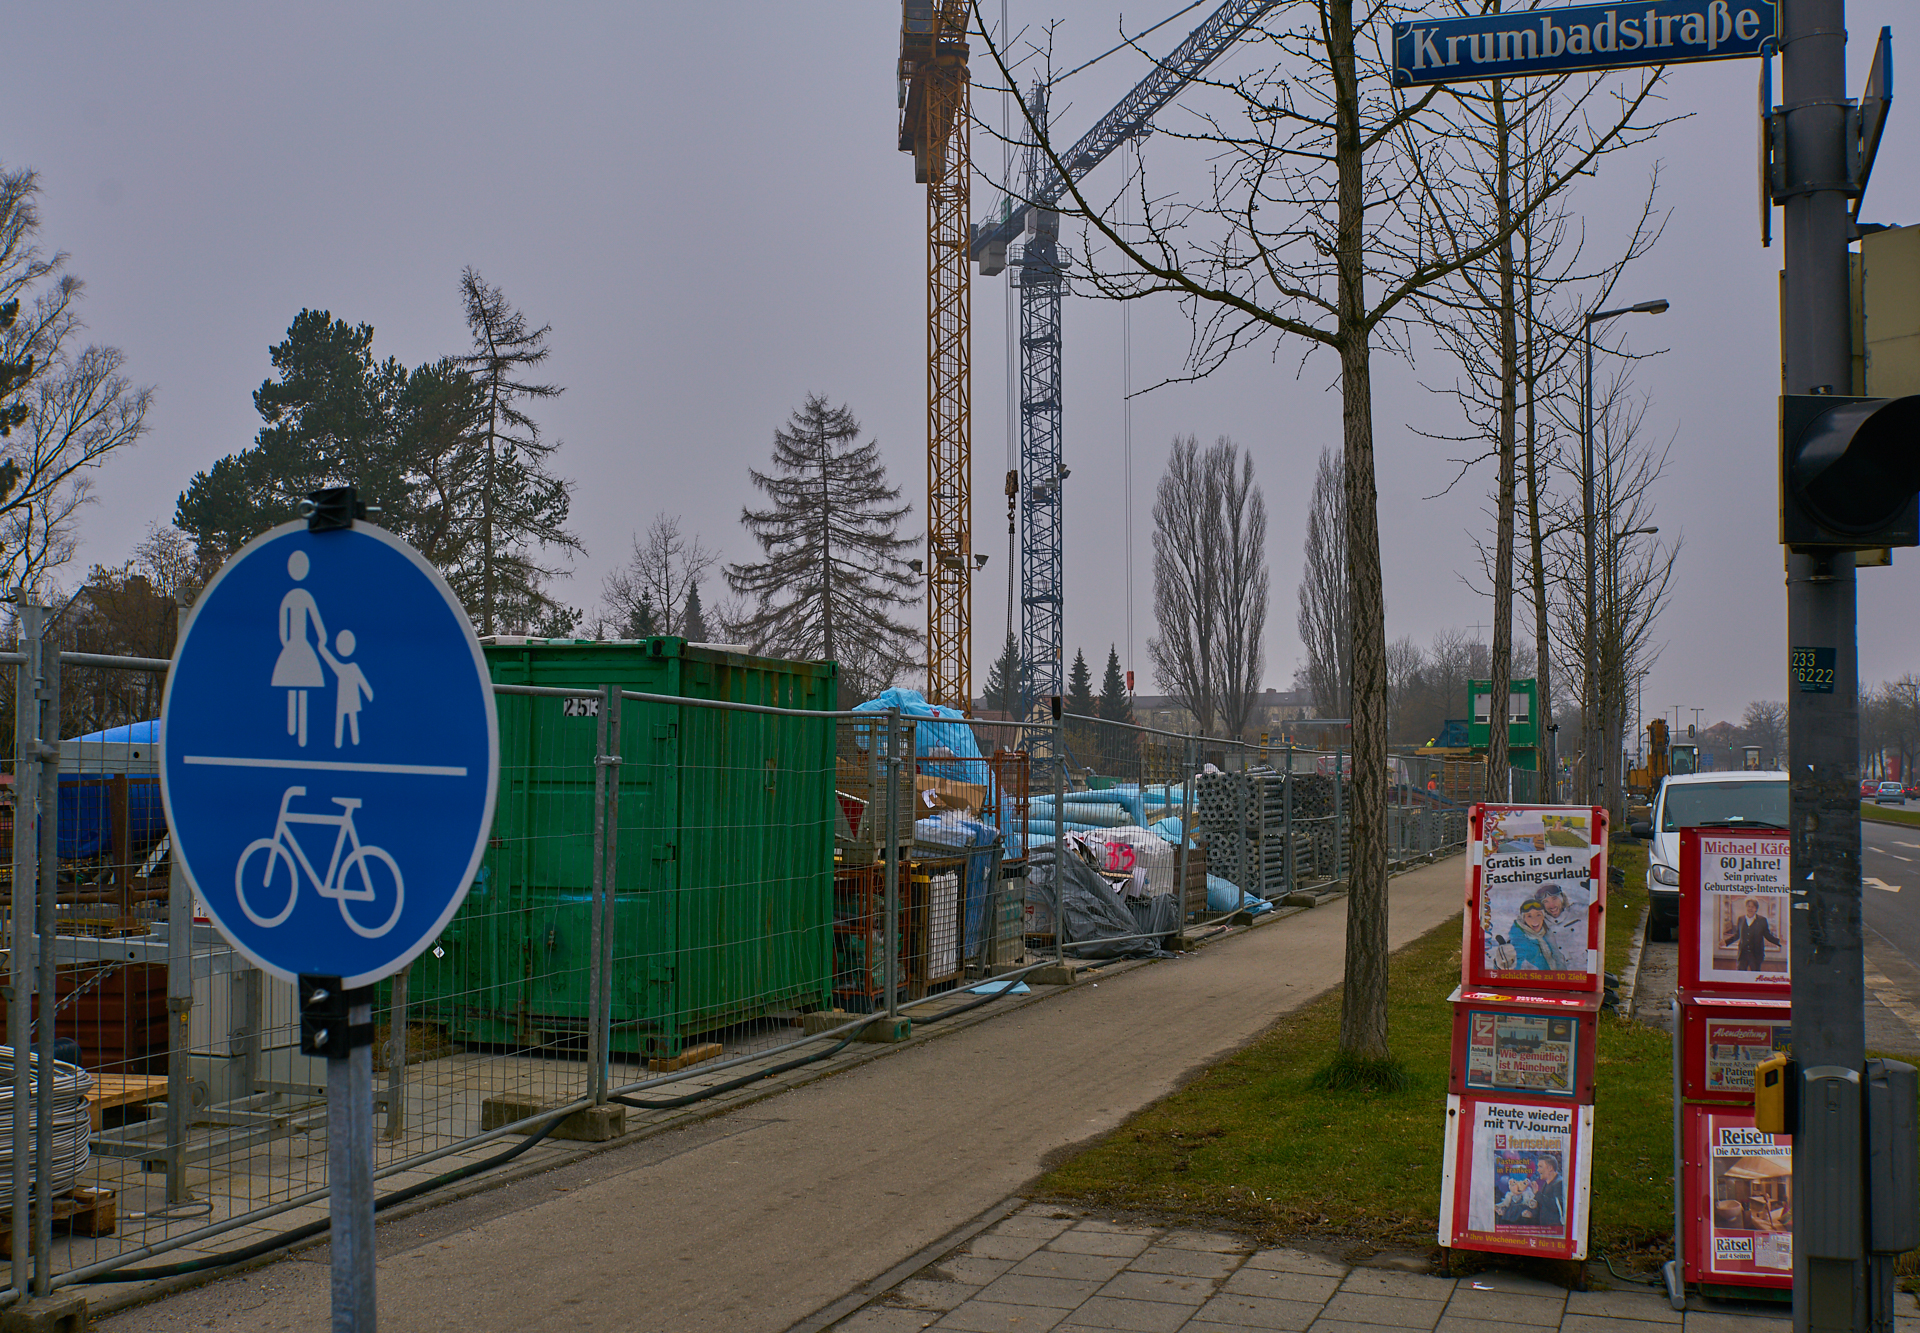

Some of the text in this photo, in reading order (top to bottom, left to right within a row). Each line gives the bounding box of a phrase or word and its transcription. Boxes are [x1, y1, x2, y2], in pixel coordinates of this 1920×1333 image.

[1411, 0, 1761, 69] Krumbadstraße
[1792, 652, 1816, 667] 233
[1704, 841, 1757, 854] Michael
[1486, 854, 1572, 869] Gratis in den
[1720, 857, 1781, 871] 60 Jahre!
[1486, 867, 1590, 884] Faschingsurlaub
[1724, 872, 1778, 884] Sein privates
[1500, 972, 1528, 980] schickt
[1530, 972, 1542, 980] Sie
[1568, 973, 1587, 981] Ziele
[1474, 1014, 1493, 1038] tz
[1713, 1028, 1767, 1040] Abendzeitung
[1500, 1049, 1566, 1062] Wie gemütlich
[1498, 1060, 1556, 1073] ist München
[1488, 1106, 1569, 1122] Heute wieder
[1484, 1118, 1572, 1134] mit TV-Journal
[1508, 1136, 1561, 1150] fernsehen
[1716, 1148, 1729, 1156] Die
[1730, 1148, 1740, 1156] AZ
[1742, 1148, 1784, 1156] verschenkt
[1496, 1158, 1530, 1166] Fastnacht
[1496, 1166, 1533, 1174] in Franken
[1485, 1234, 1528, 1246] Wochenend-
[1538, 1240, 1550, 1248] für
[1716, 1238, 1752, 1251] Rätsel
